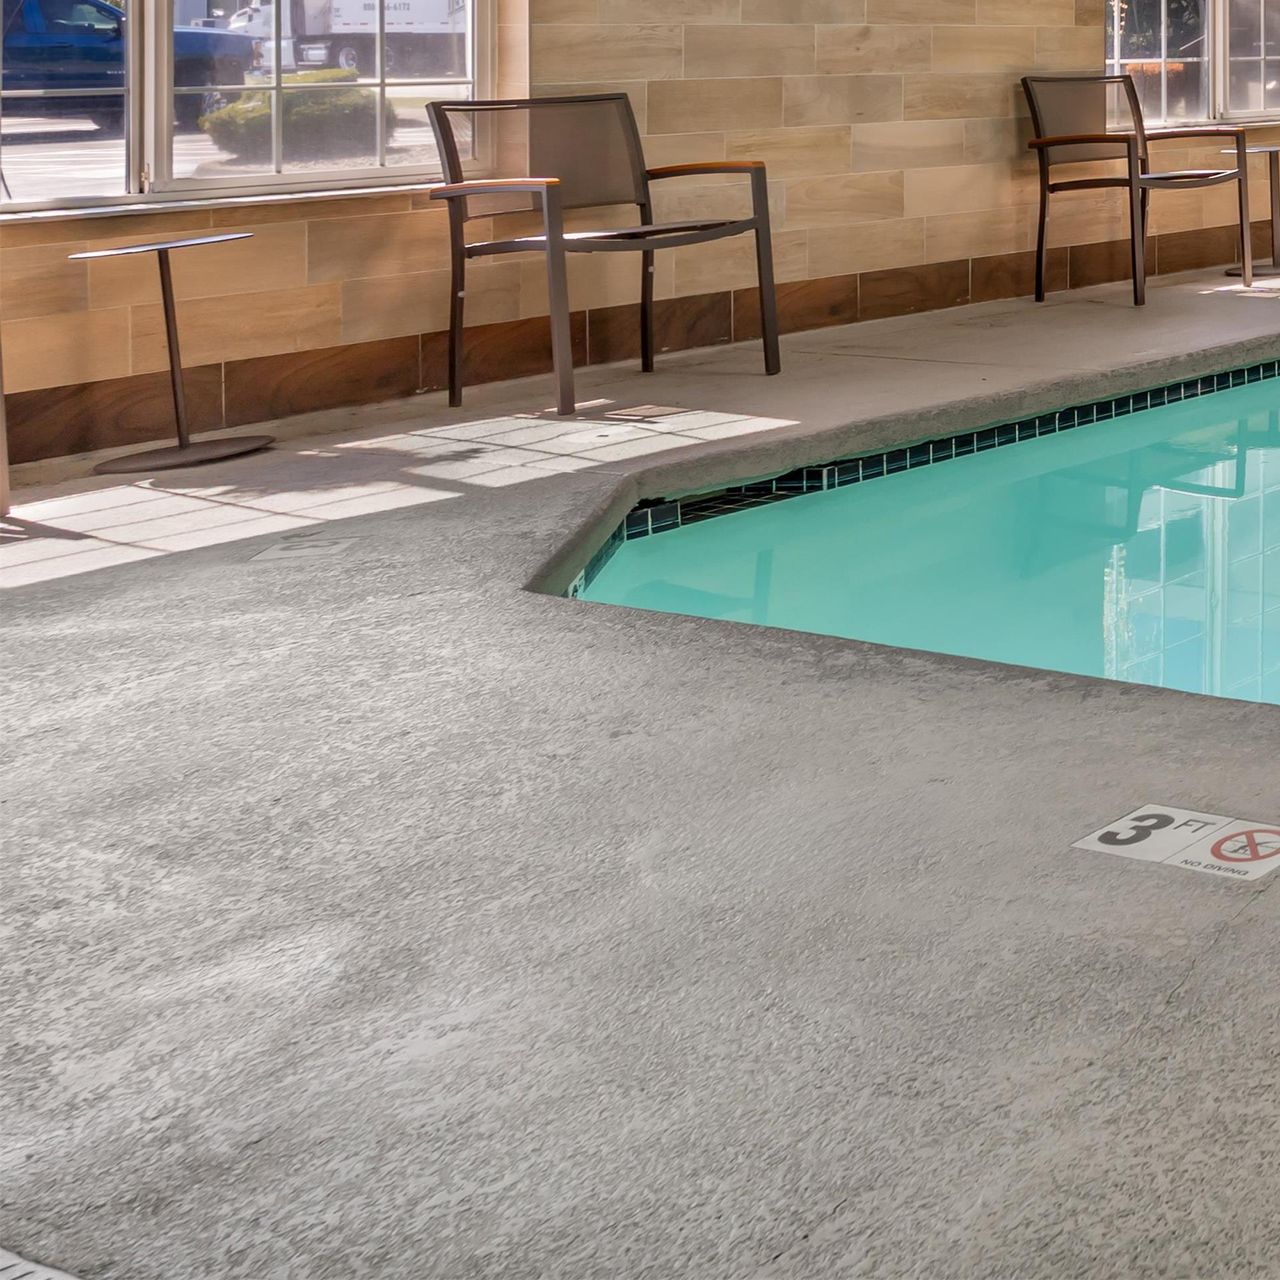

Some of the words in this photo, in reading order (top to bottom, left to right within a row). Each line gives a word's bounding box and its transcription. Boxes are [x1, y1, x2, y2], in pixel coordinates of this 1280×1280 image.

[1097, 813, 1175, 846] 3
[1173, 819, 1216, 833] FT
[1180, 859, 1202, 867] NO
[1203, 864, 1249, 876] DIVING
